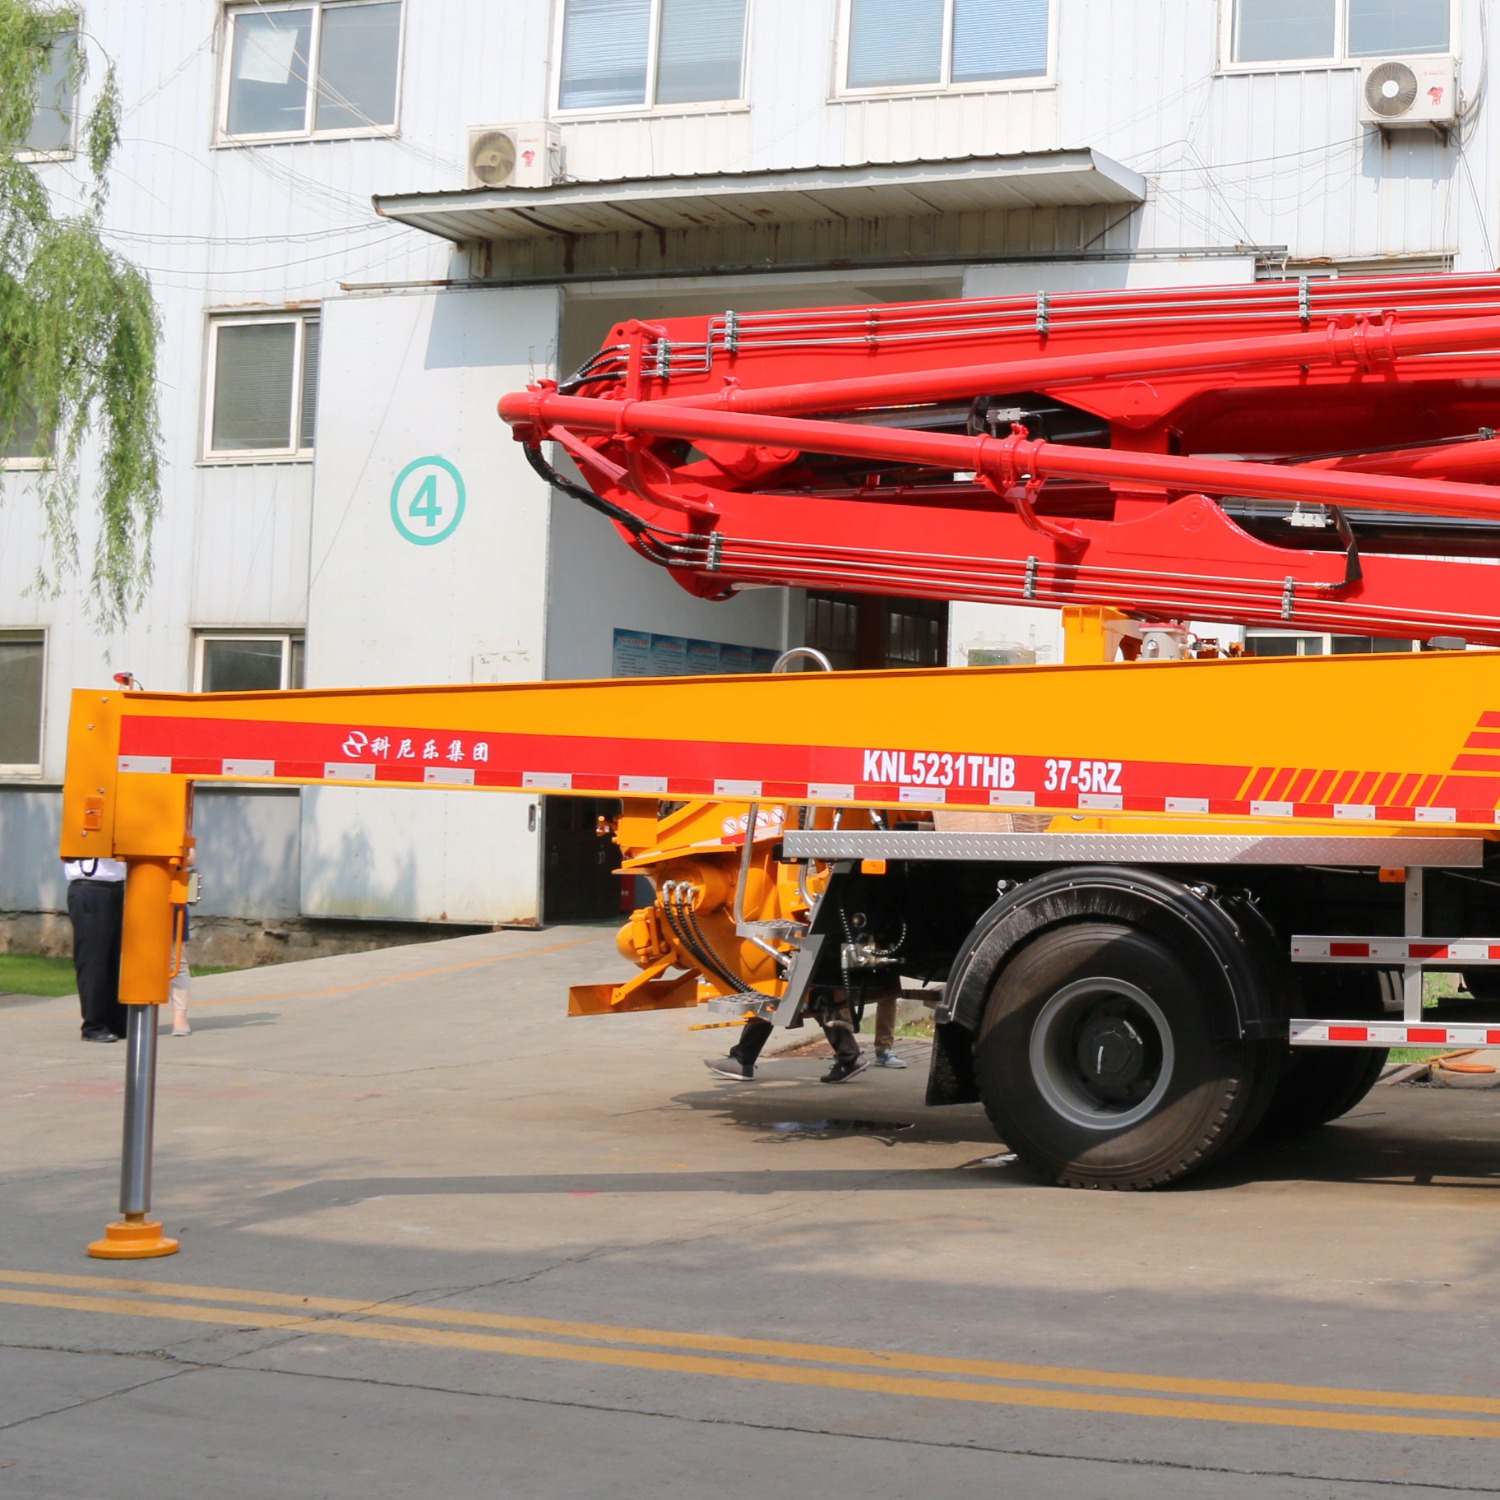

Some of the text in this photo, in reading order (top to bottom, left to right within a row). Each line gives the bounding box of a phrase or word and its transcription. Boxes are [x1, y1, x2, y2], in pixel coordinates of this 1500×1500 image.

[370, 736, 489, 763] 科尼乐集团
[863, 749, 1123, 794] KNL5231THB 37-5RZ
